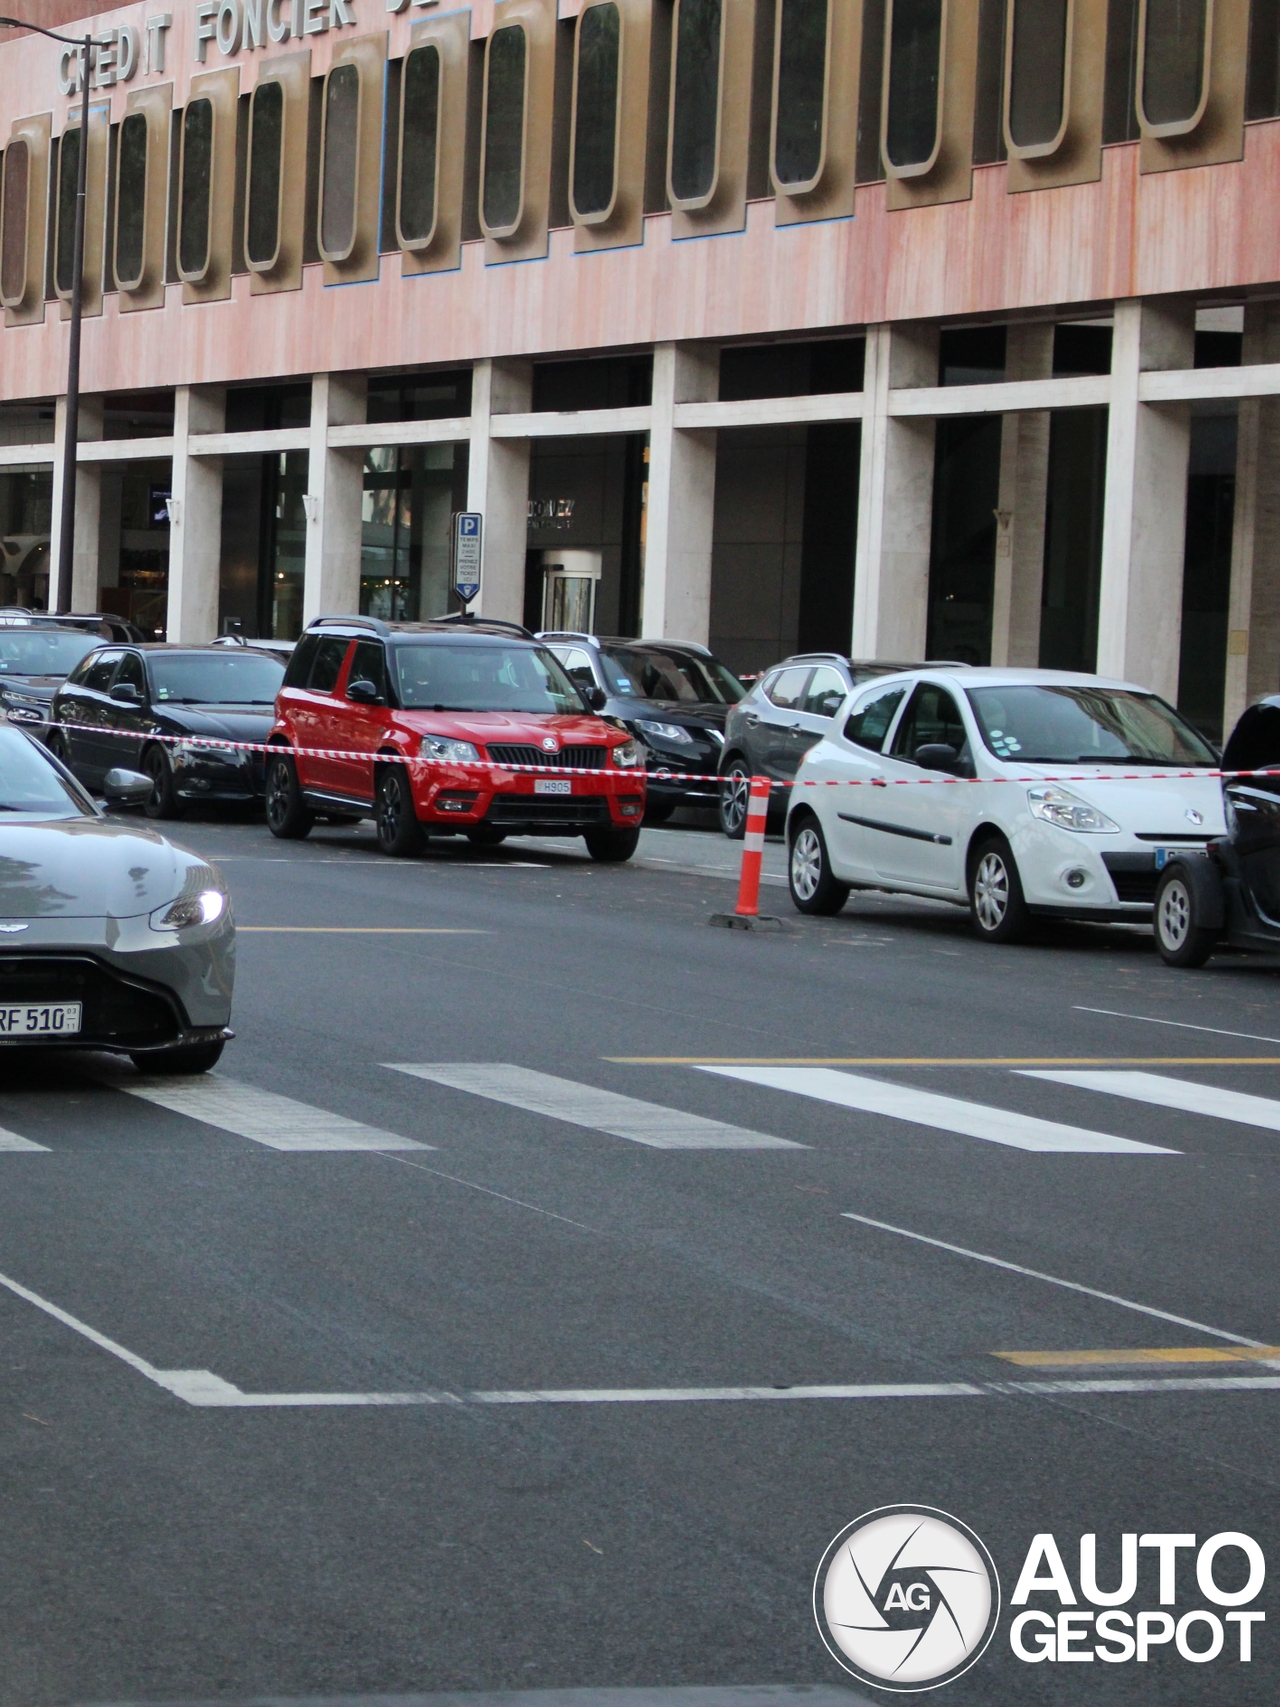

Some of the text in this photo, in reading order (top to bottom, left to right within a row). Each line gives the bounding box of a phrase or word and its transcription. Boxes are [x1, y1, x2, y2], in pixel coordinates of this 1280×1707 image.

[464, 518, 475, 534] P
[544, 782, 570, 793] H905
[26, 1008, 64, 1031] 510
